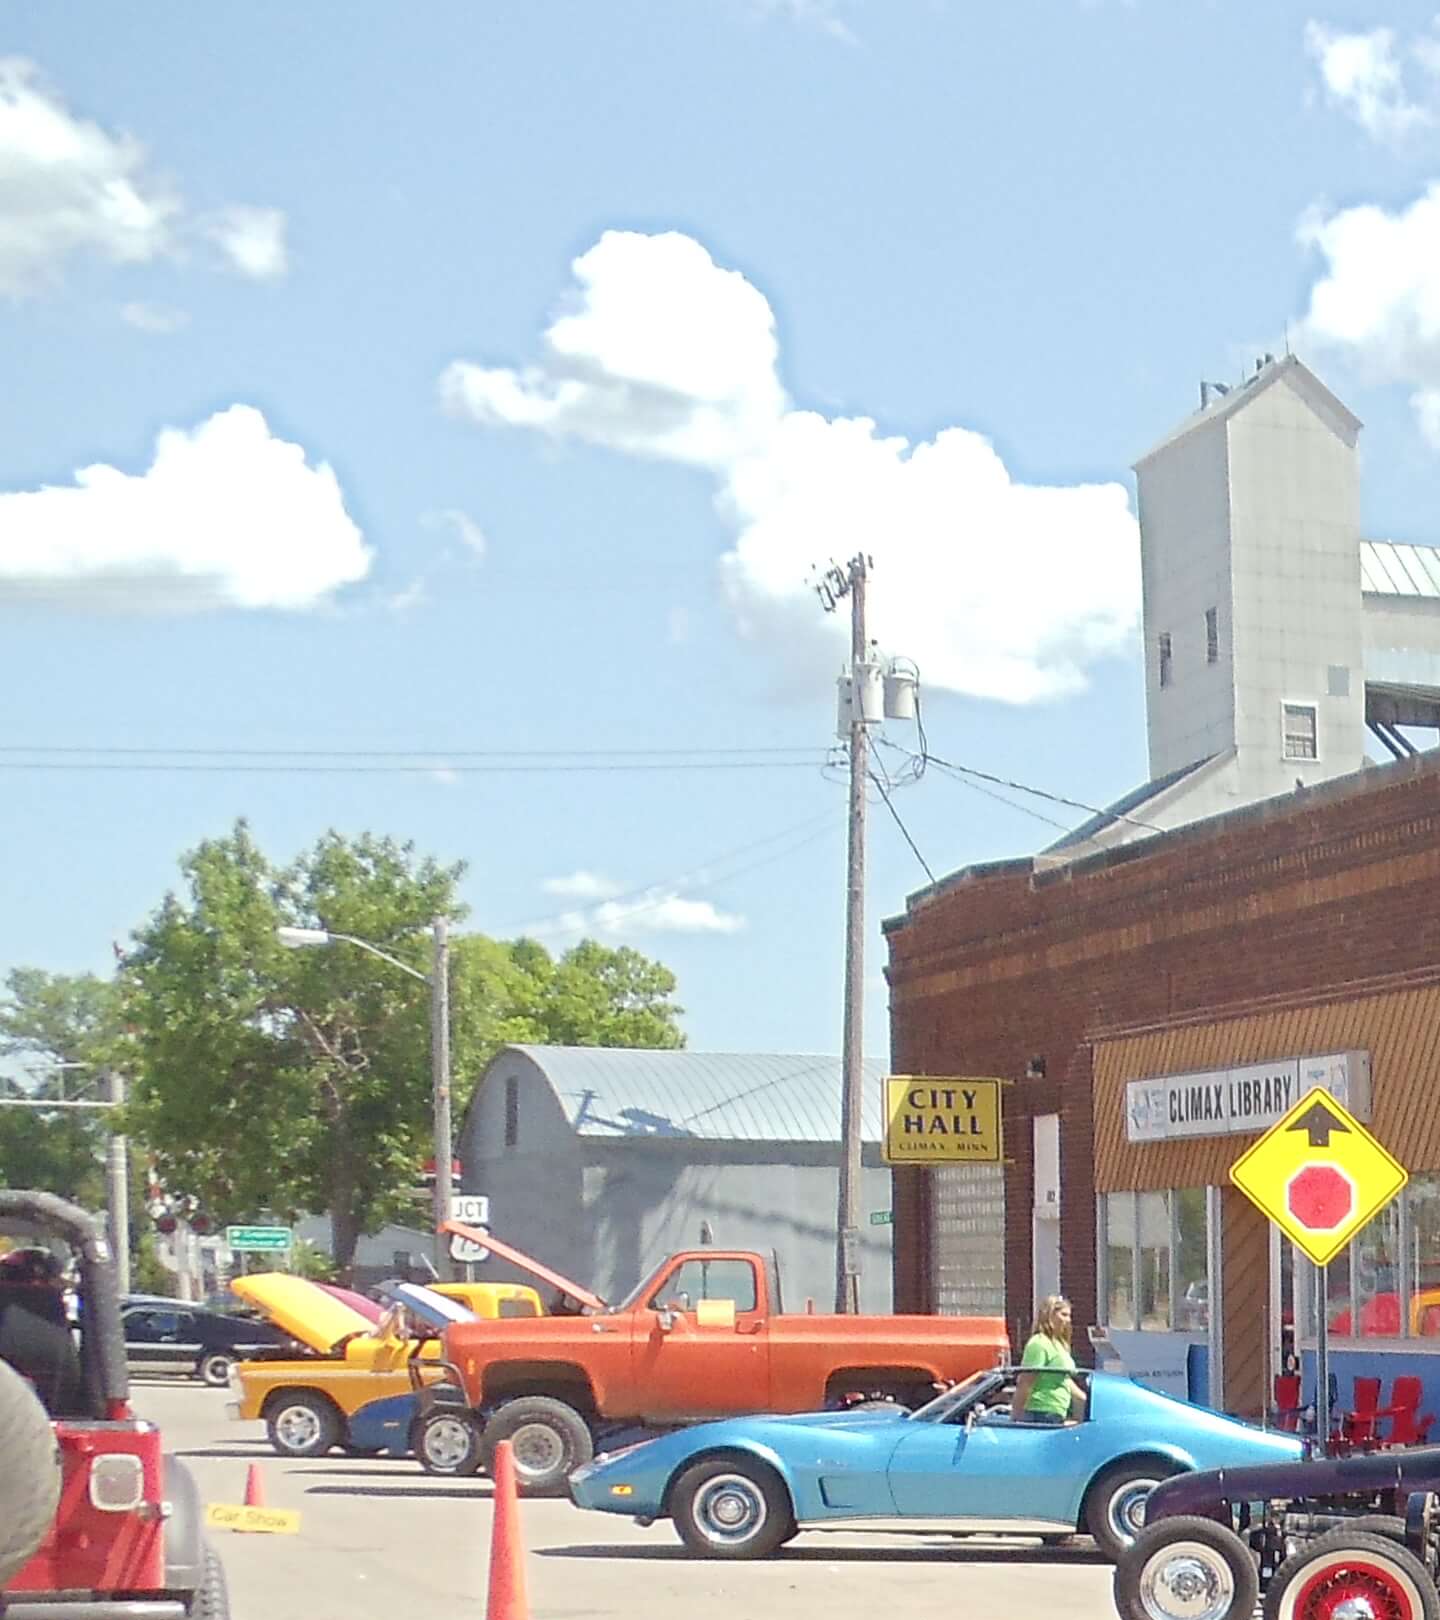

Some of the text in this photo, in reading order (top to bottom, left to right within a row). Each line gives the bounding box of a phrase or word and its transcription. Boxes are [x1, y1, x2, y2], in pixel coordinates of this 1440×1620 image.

[907, 1087, 978, 1110] CITY
[1168, 1083, 1224, 1124] CLIMAX
[1229, 1074, 1292, 1118] LIBRARY
[903, 1113, 984, 1136] HALL
[455, 1201, 483, 1218] JCT
[211, 1507, 241, 1522] Car
